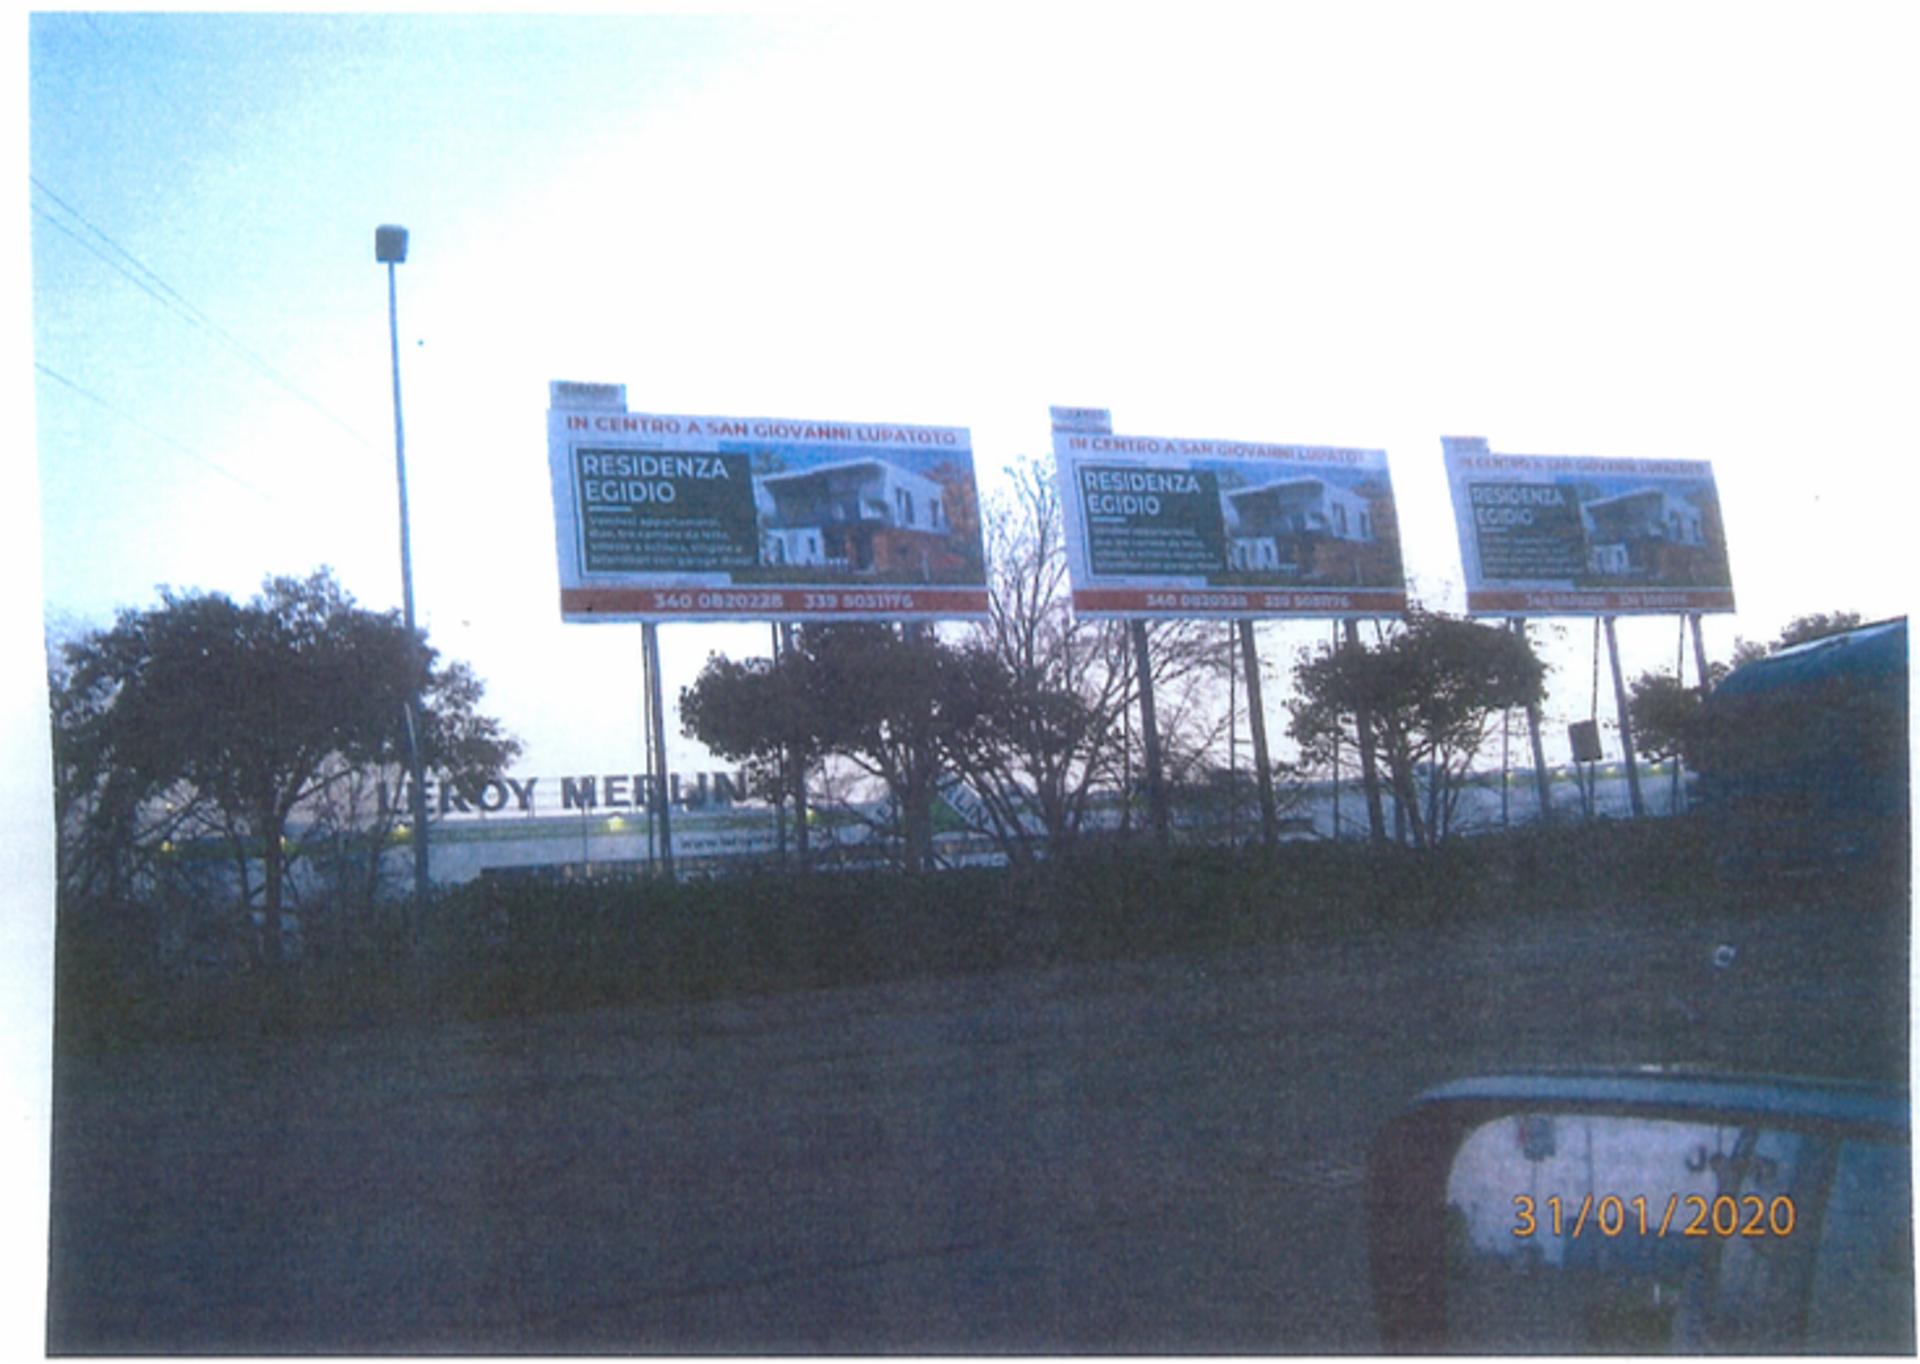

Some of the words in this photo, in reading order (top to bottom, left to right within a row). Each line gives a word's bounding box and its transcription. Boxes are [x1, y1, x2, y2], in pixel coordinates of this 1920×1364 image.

[567, 415, 588, 430] IN
[595, 417, 681, 434] CENTRO
[687, 420, 702, 434] A
[707, 421, 748, 437] SAN
[754, 423, 850, 440] GIOVANNI
[857, 428, 957, 445] LUPATOTO
[1069, 437, 1088, 450] IN
[1093, 438, 1159, 454] CENTRO
[1164, 441, 1175, 454] A
[1183, 442, 1212, 456] SAN
[1218, 444, 1295, 459] GIOVANNI
[583, 455, 729, 480] RESIDENZA
[585, 479, 677, 504] EGIDIO
[1085, 470, 1201, 494] RESIDENZA
[1087, 493, 1161, 516] EGIDIO
[1472, 485, 1566, 507] RESIDENZA
[1476, 507, 1535, 527] EGIDIO
[653, 592, 692, 609] 340
